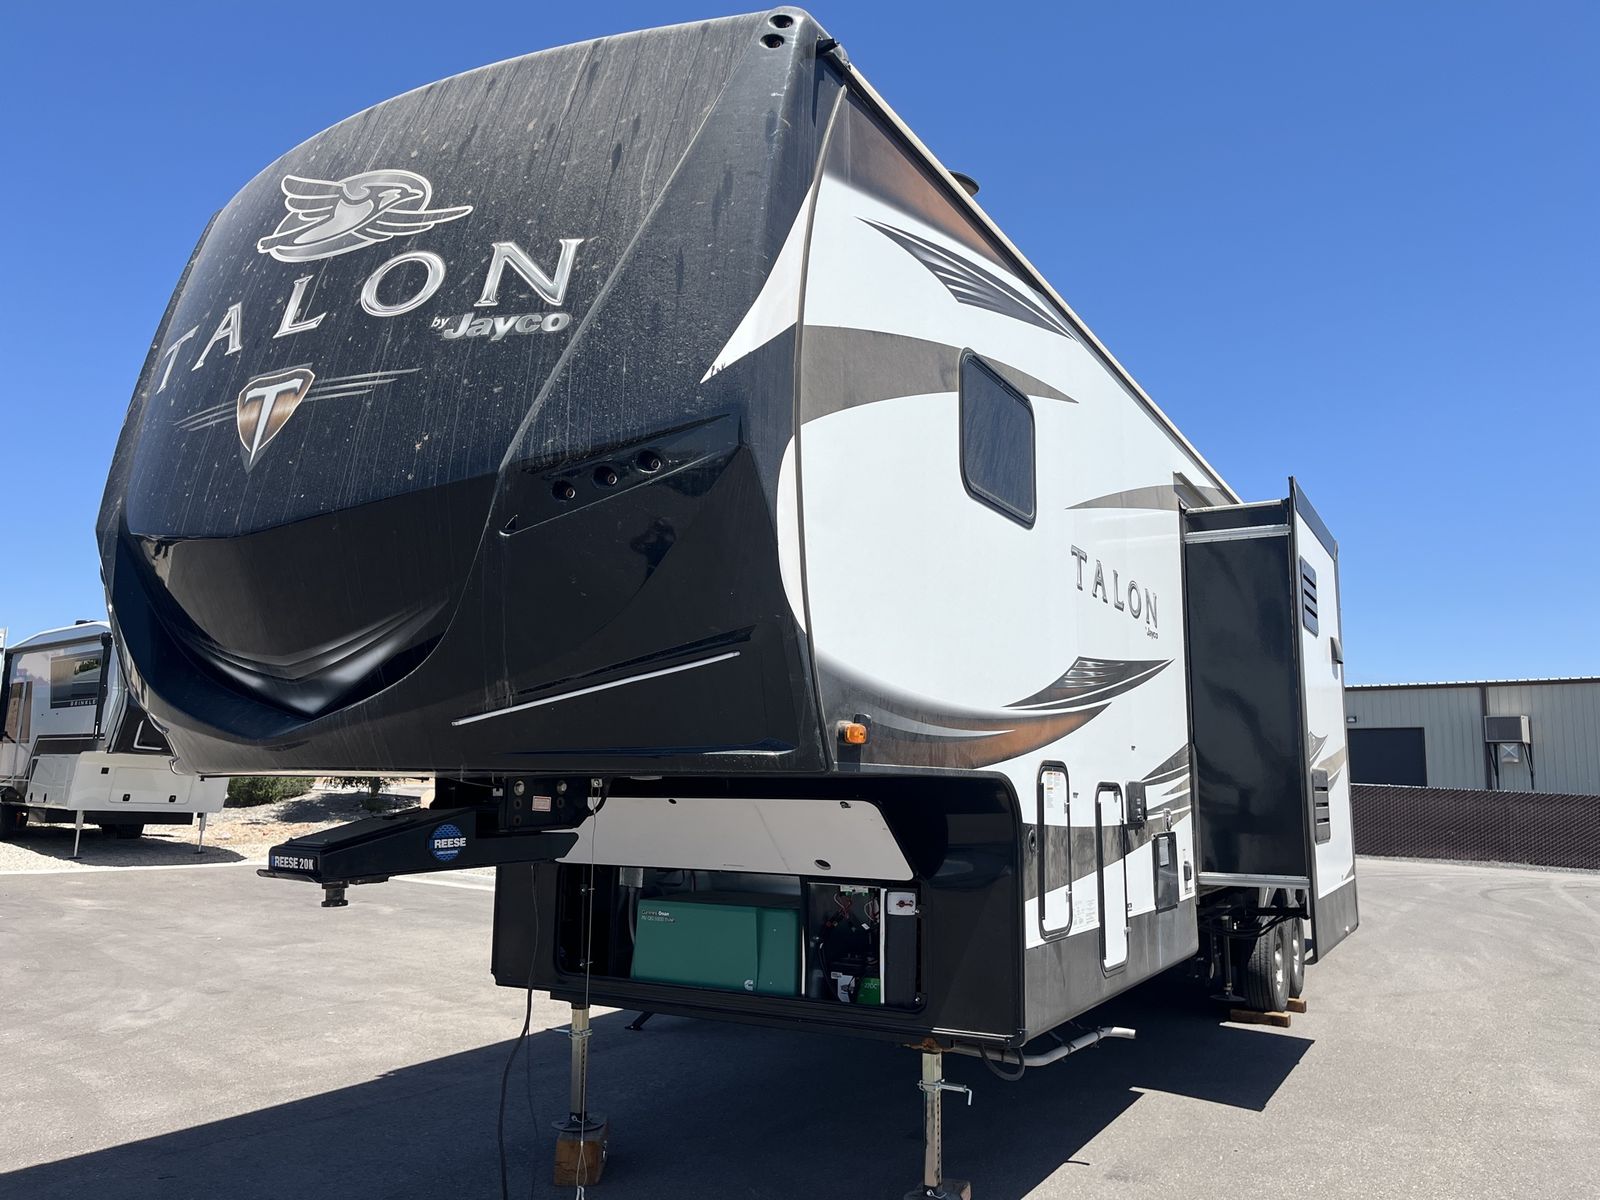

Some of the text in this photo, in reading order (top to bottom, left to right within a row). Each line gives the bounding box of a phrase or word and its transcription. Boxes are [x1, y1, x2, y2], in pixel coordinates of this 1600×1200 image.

[156, 238, 585, 395] TALON
[431, 312, 570, 341] by Jayco
[1070, 544, 1158, 629] TALON
[434, 837, 467, 849] REESE
[274, 856, 314, 870] REESE 20K
